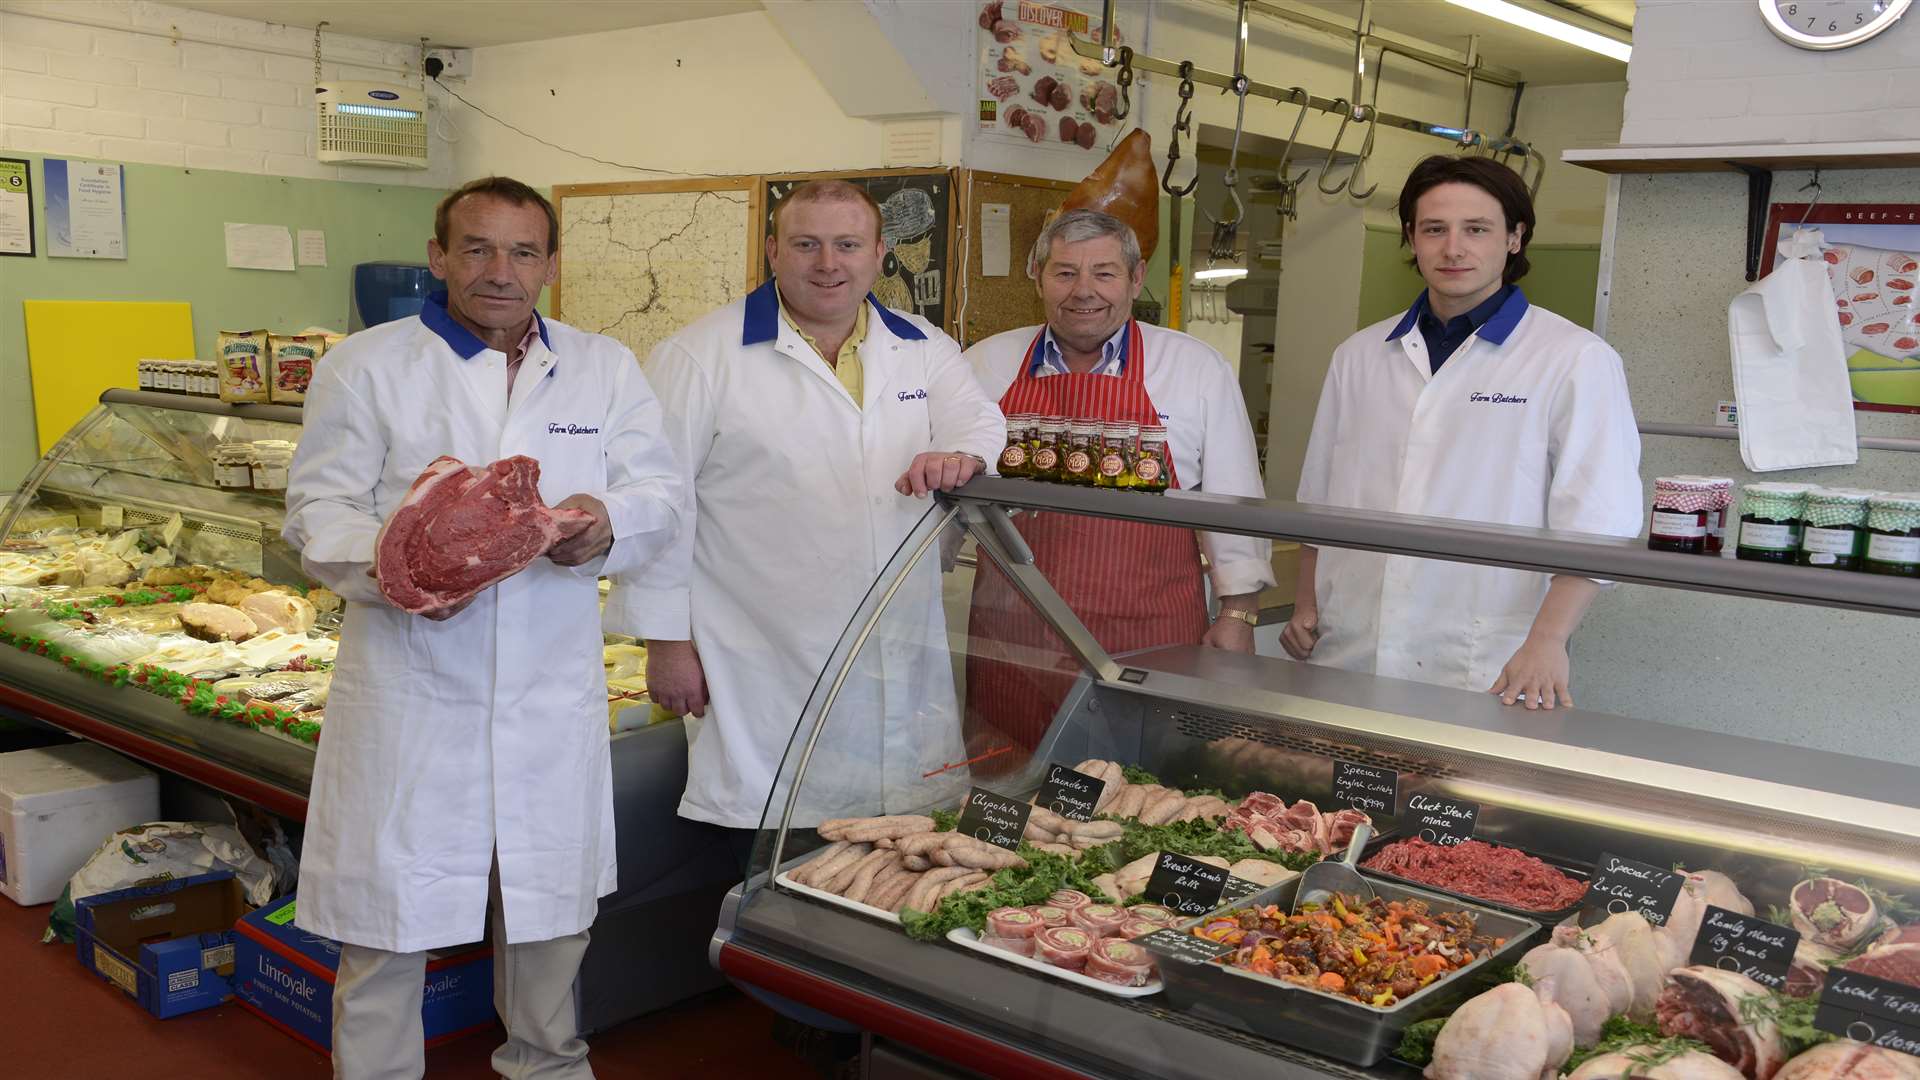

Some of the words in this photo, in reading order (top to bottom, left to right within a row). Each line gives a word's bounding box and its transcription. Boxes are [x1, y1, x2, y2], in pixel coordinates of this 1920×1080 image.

[1788, 4, 1797, 15] 8
[1020, 3, 1063, 28] DISCOVER
[1064, 12, 1087, 34] LAMB
[1807, 17, 1816, 28] 7
[1855, 13, 1863, 24] 5
[1828, 21, 1837, 31] 6
[12, 177, 20, 186] 5
[1846, 212, 1887, 220] BEEF
[897, 391, 916, 402] Farm
[1470, 392, 1490, 402] Farm
[1491, 392, 1528, 403] Butchers
[548, 422, 567, 434] Farm
[567, 423, 599, 435] Butchers
[1343, 764, 1381, 778] Special
[972, 793, 1019, 817] Chipolata
[1056, 789, 1092, 810] Sausages
[1441, 804, 1473, 819] Steak
[983, 810, 1019, 830] Sausages
[1162, 854, 1193, 873] Breast
[1194, 867, 1222, 883] Lamb
[258, 954, 313, 1001] Linroyale
[424, 975, 458, 998] oyale
[1831, 976, 1879, 1000] Local
